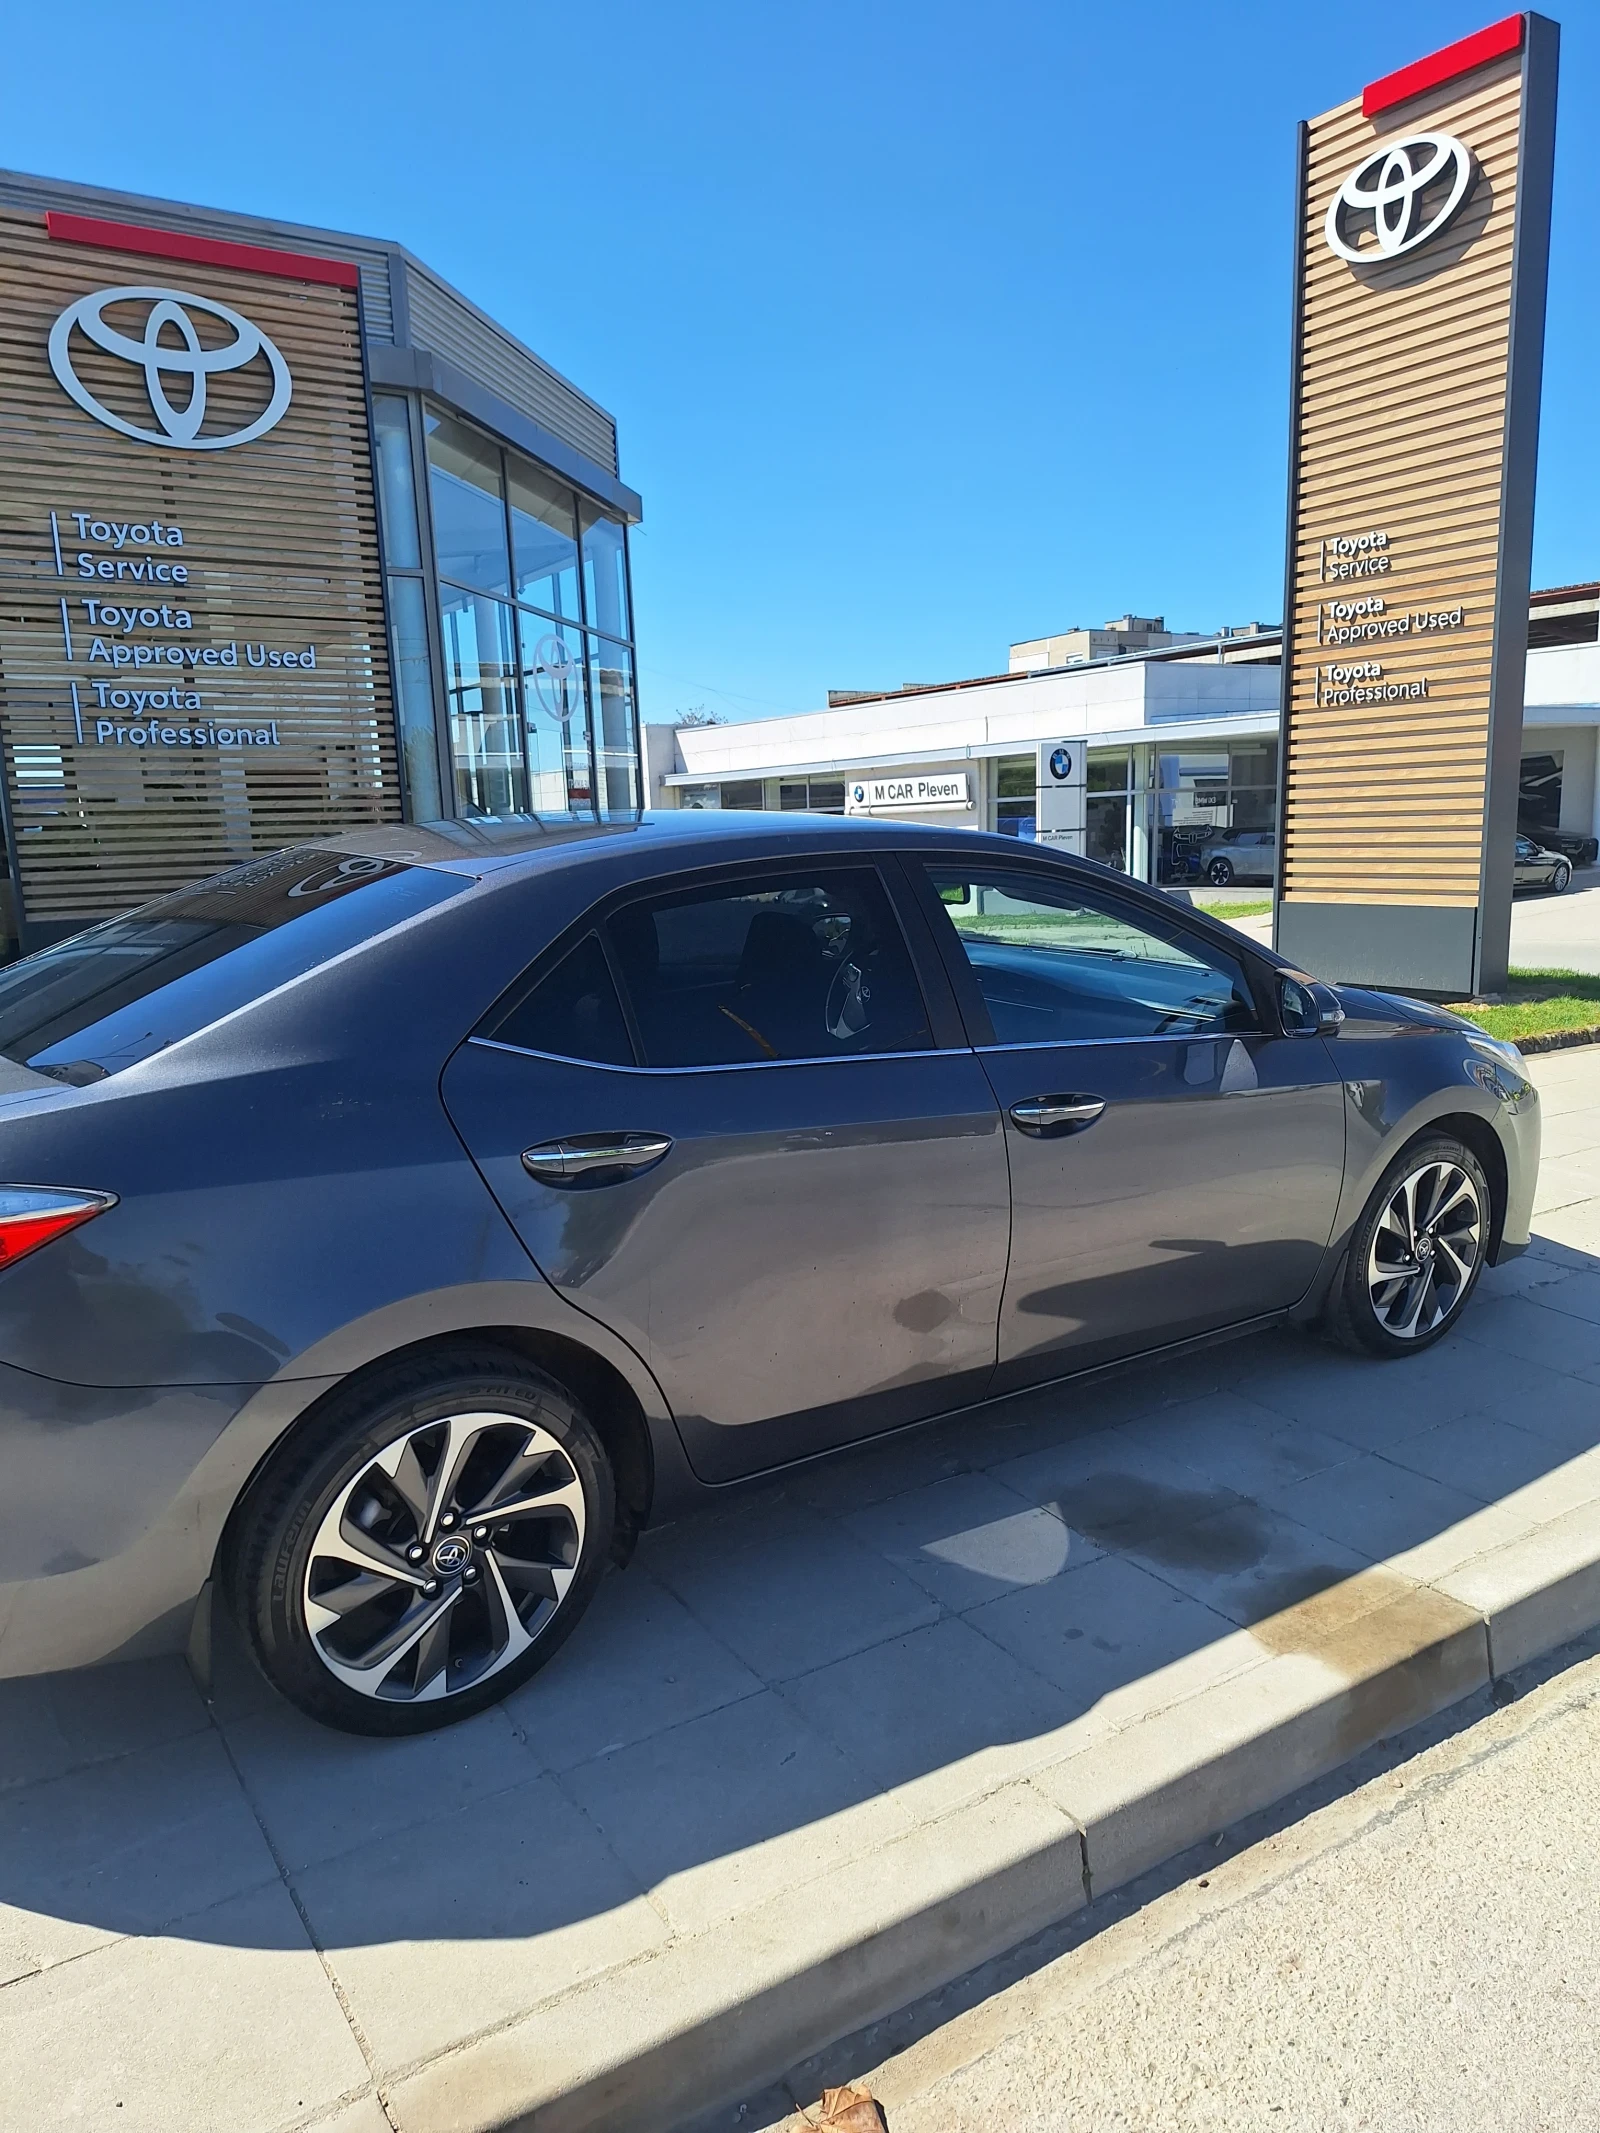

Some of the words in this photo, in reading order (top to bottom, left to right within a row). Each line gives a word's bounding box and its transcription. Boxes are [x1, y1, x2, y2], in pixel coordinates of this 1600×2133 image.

[71, 512, 184, 549] Toyota
[1331, 532, 1387, 555] Toyota
[78, 552, 189, 583] Service
[1329, 555, 1390, 579] Service
[81, 598, 193, 633] Toyota
[1327, 597, 1384, 620] Toyota
[1326, 613, 1410, 644] Approved
[1415, 606, 1463, 630] Used
[89, 638, 239, 669] Approved
[246, 644, 317, 669] Used
[1325, 662, 1381, 684] Toyota
[92, 682, 202, 715] Toyota
[1324, 677, 1427, 704] Professional
[96, 720, 280, 746] Professional
[875, 785, 886, 800] M
[887, 783, 914, 800] CAR
[917, 781, 959, 798] Pleven
